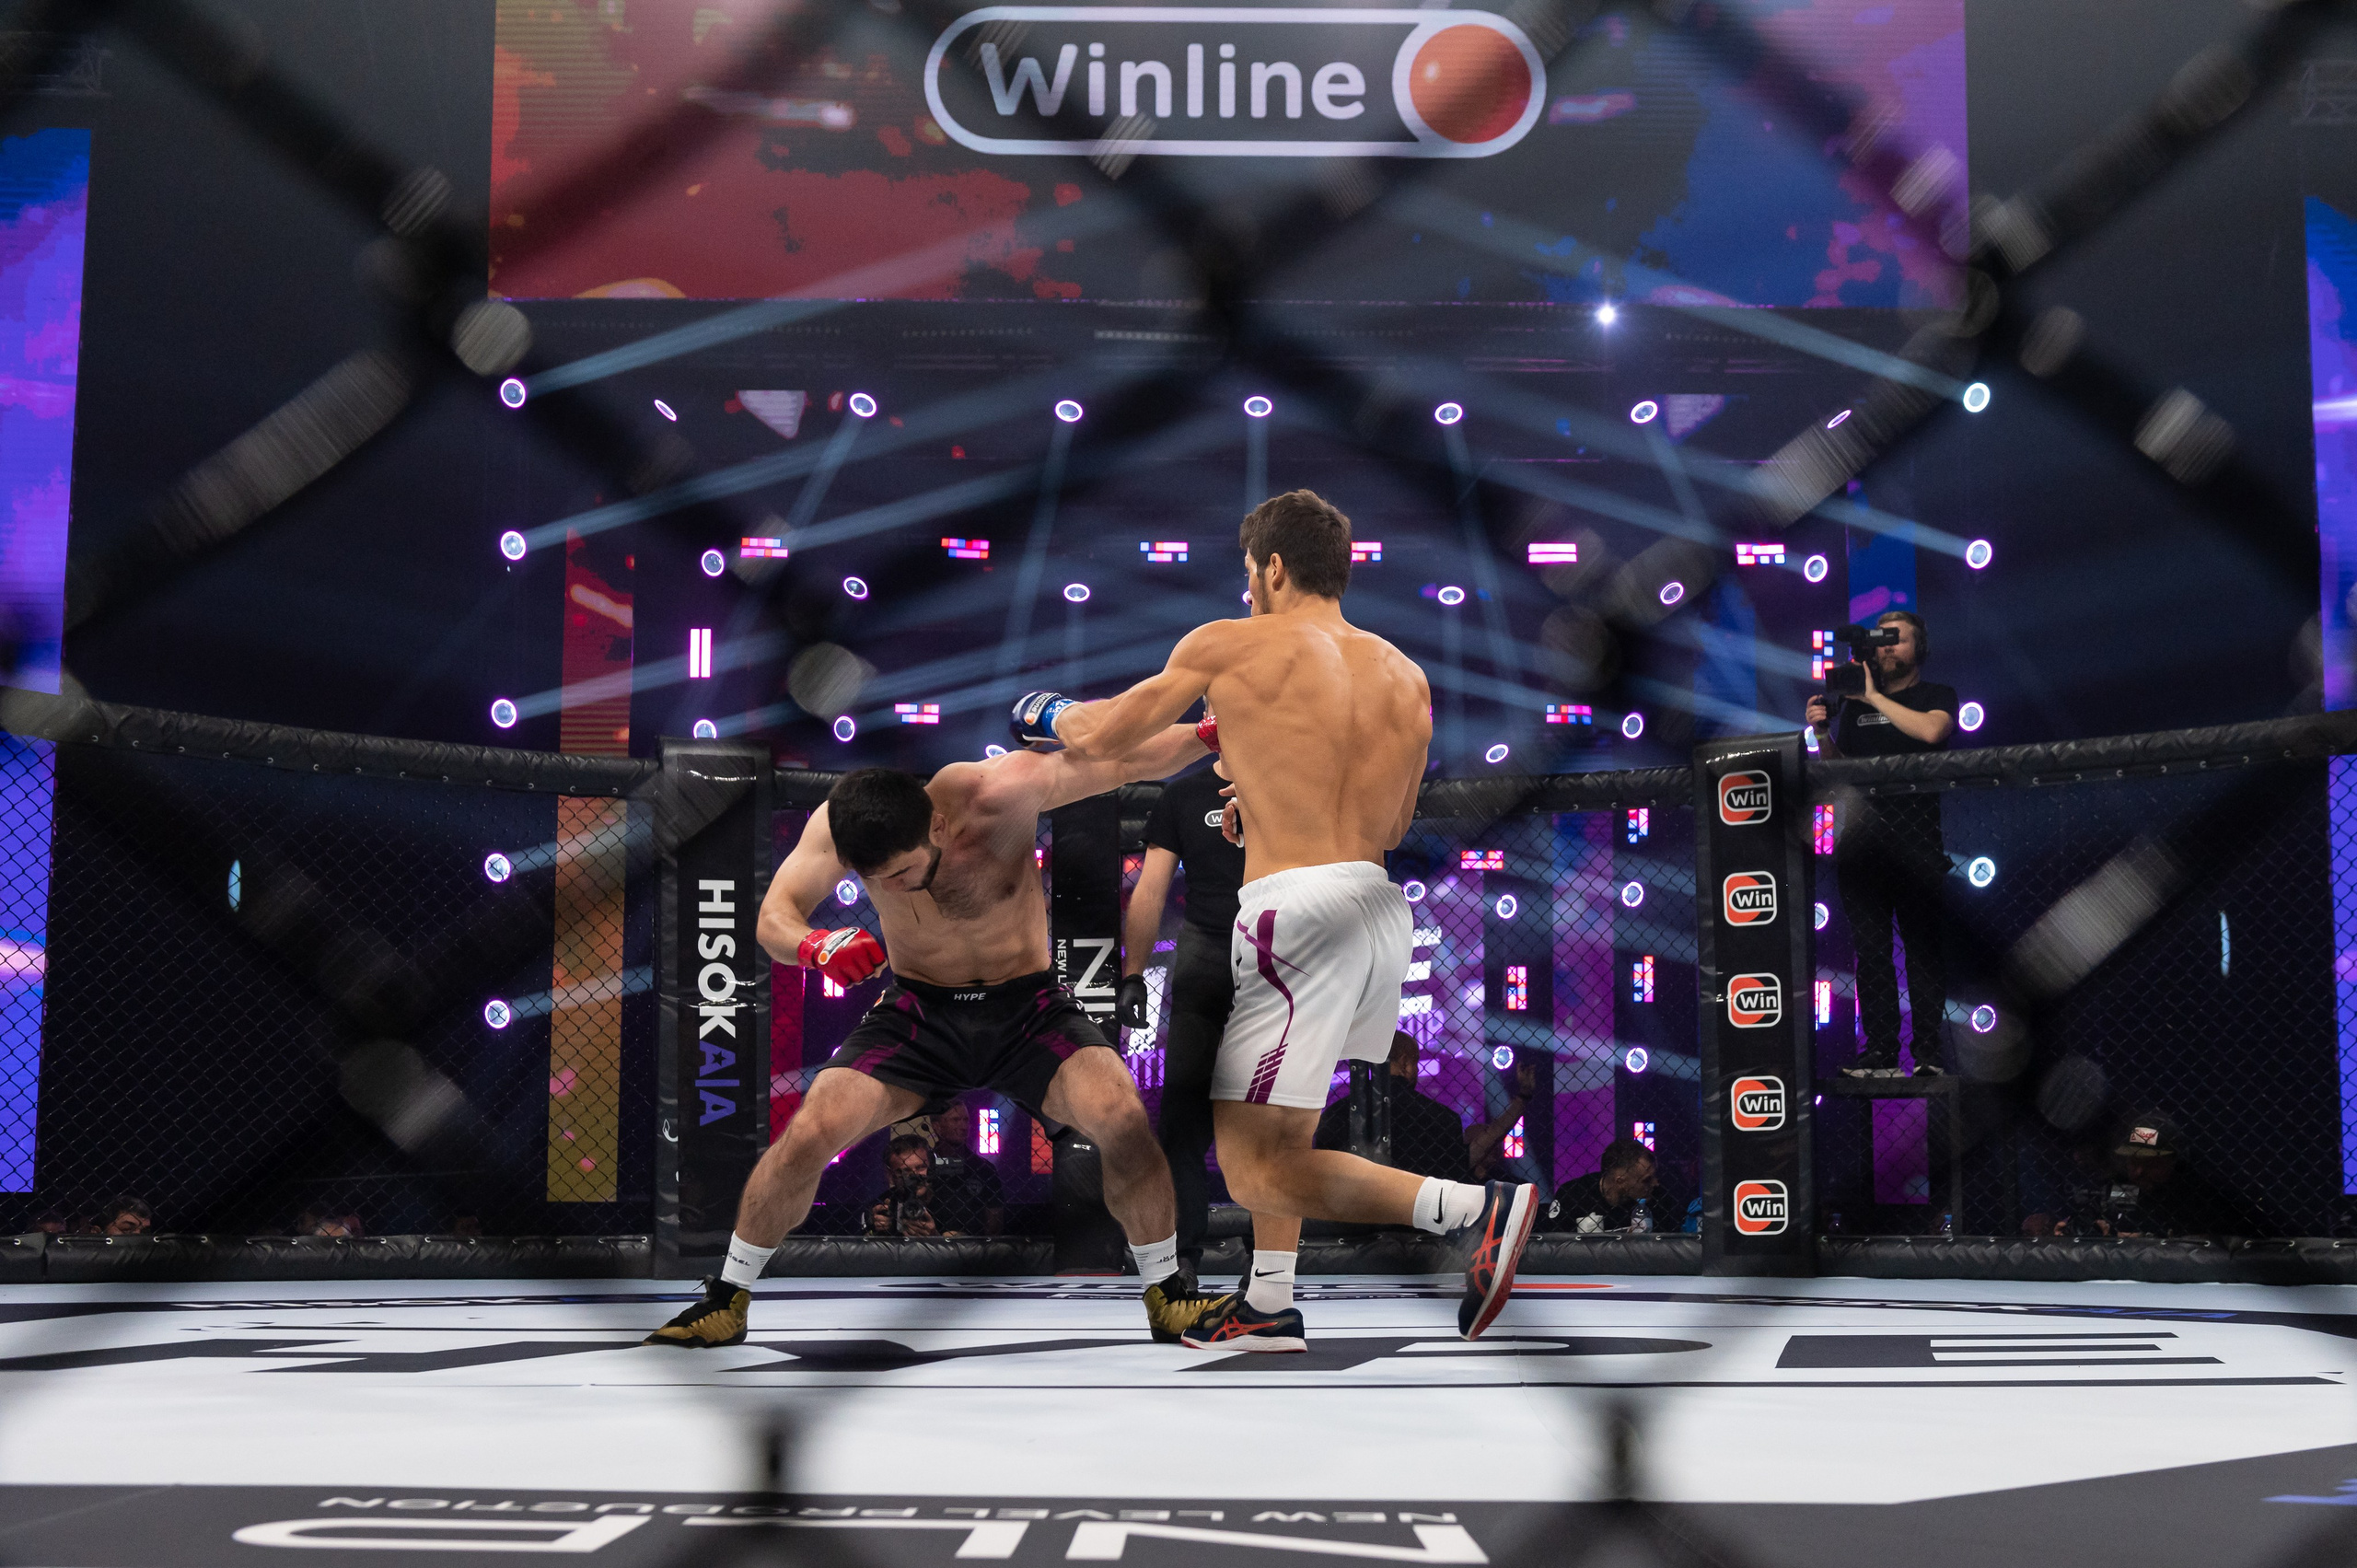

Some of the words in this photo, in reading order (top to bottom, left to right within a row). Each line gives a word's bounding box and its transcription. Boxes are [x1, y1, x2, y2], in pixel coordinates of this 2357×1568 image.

[981, 42, 1366, 120] Winline
[1730, 790, 1767, 807] Win
[1736, 890, 1772, 908] Win
[1057, 938, 1067, 971] NEW
[954, 993, 987, 1001] HYPE
[1740, 993, 1777, 1009] Win
[1743, 1096, 1781, 1112] Win
[1746, 1200, 1784, 1216] Win
[944, 1507, 1225, 1522] LEVEL
[1251, 1511, 1458, 1524] NEW
[233, 1515, 1489, 1564] NLP
